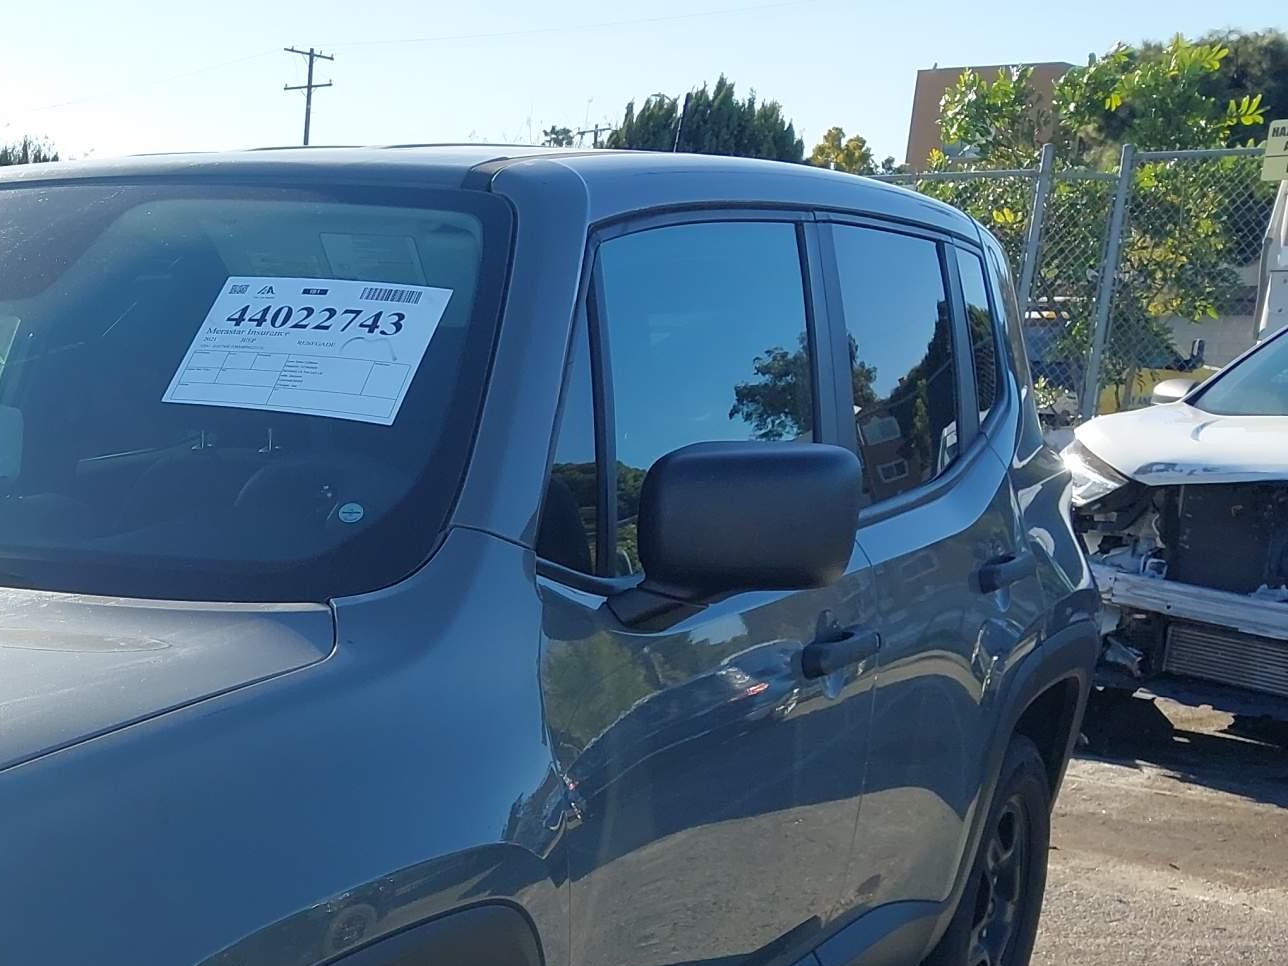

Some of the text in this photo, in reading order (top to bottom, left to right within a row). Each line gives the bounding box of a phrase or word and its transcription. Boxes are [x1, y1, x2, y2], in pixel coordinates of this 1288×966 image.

[1272, 126, 1288, 137] HA
[226, 304, 406, 336] 44022743
[206, 327, 246, 335] Merastar
